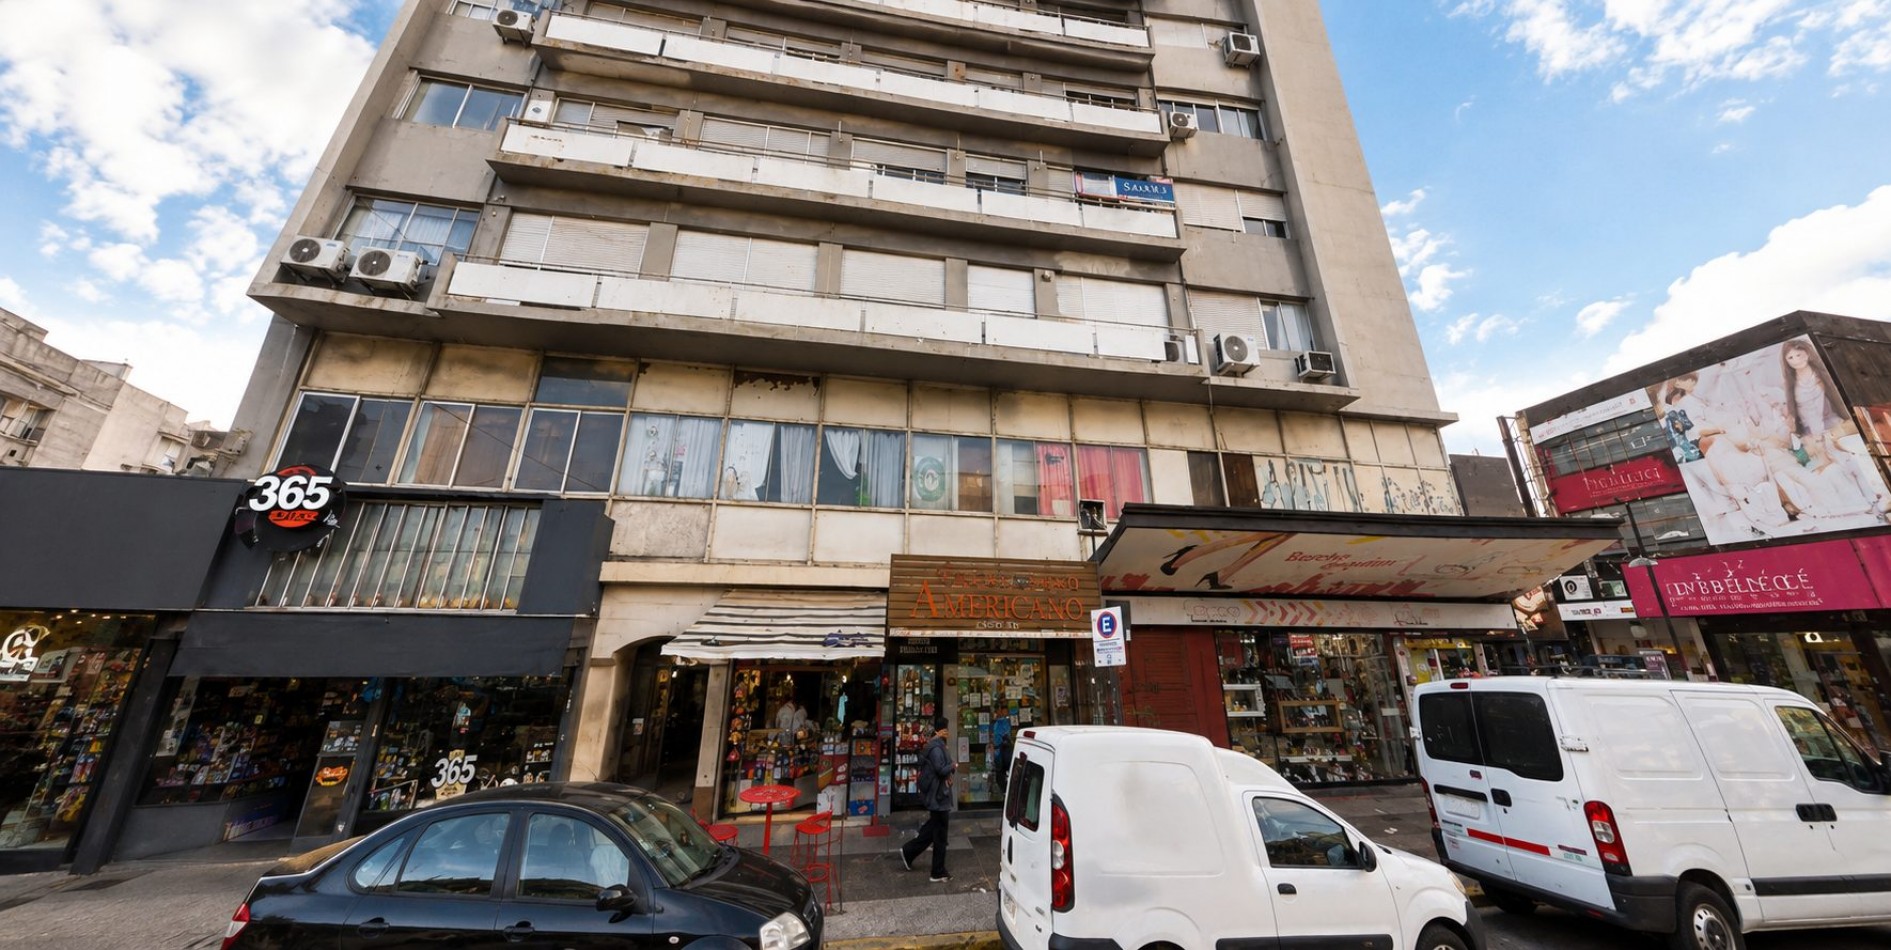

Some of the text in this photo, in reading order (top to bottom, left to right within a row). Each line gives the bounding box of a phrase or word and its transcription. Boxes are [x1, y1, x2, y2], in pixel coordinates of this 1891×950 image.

[249, 475, 333, 511] 365
[910, 579, 1084, 621] AMERICANO
[1102, 616, 1112, 633] E
[430, 755, 478, 788] 365
